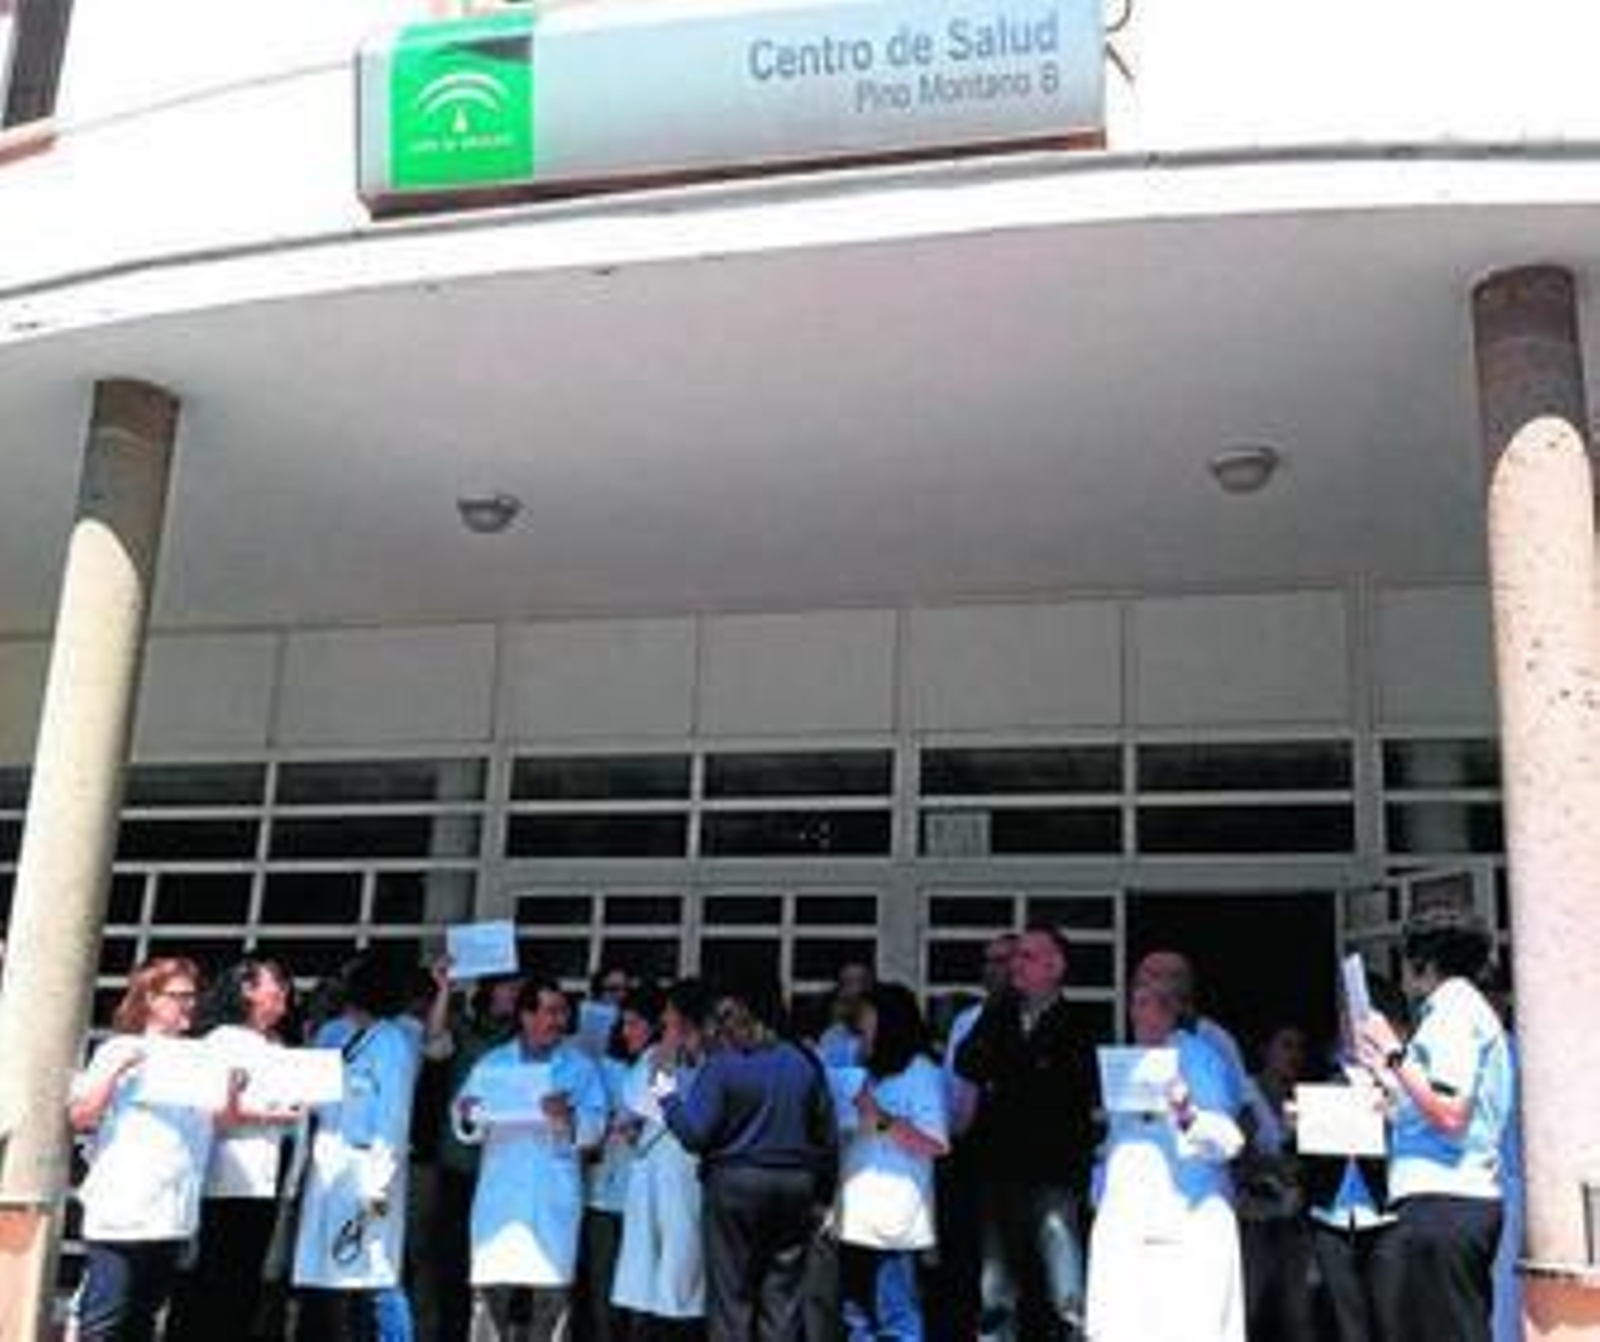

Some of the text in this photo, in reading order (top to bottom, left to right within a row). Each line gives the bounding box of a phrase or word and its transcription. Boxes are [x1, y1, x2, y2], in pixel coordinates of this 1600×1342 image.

[749, 9, 1059, 81] Centro de Salud
[856, 79, 911, 113] Pino
